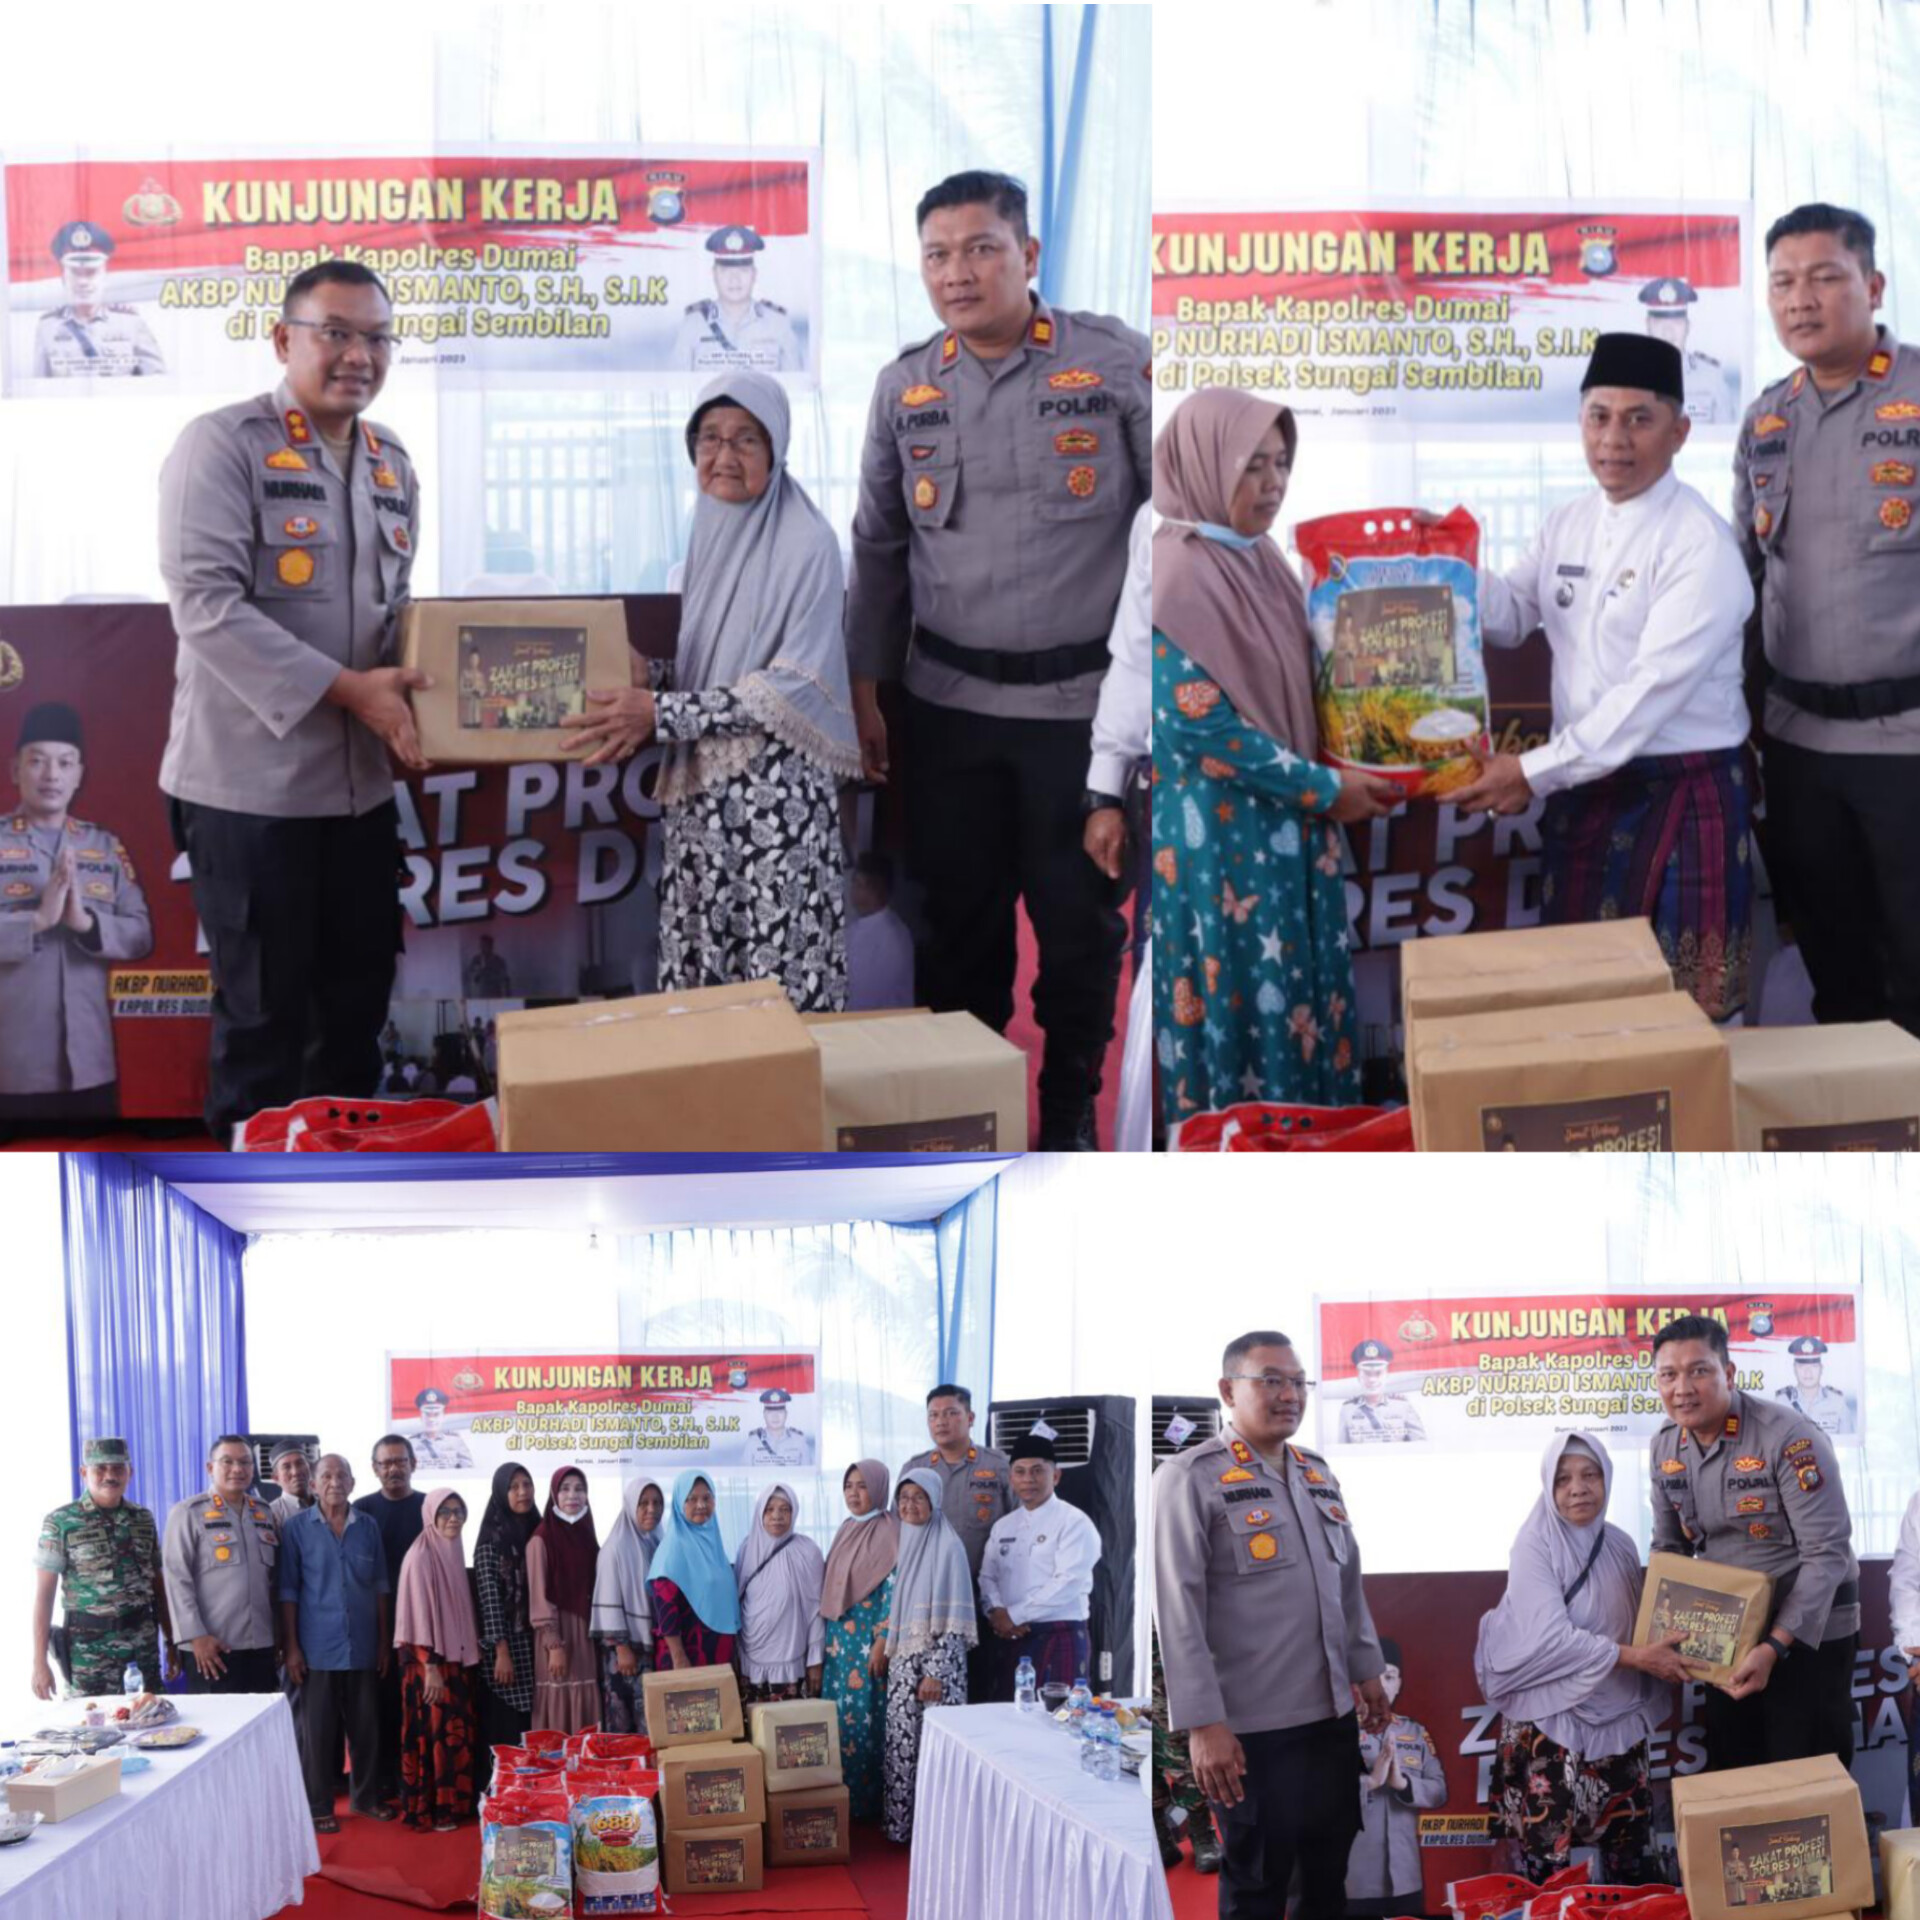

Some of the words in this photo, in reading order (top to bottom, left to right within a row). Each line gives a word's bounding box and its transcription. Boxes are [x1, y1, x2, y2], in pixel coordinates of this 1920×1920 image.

[203, 178, 465, 226] KUNJUNGAN
[481, 177, 620, 225] KERJA
[244, 245, 336, 275] Bapak
[342, 244, 476, 275] Kapolres
[482, 242, 578, 272] Dumai
[1412, 231, 1552, 275] KERJA
[160, 279, 238, 308] AKBP
[386, 275, 529, 309] ISMANTO,
[535, 276, 598, 310] S.H.,
[604, 276, 669, 306] S.I.K
[1176, 295, 1267, 327] Bapak
[1275, 295, 1408, 328] Kapolres
[1413, 294, 1511, 323] Dumai
[226, 310, 256, 338] di
[392, 308, 467, 343] ngai
[473, 309, 611, 338] Sembilan
[1174, 327, 1312, 357] NURHADI
[1317, 326, 1461, 361] ISMANTO,
[1467, 327, 1531, 361] S.H.,
[1536, 327, 1600, 357] S.I.K
[1157, 362, 1186, 391] di
[1192, 362, 1290, 390] Polsek
[1295, 359, 1398, 396] Sungai
[1403, 360, 1542, 390] Sembilan
[1039, 393, 1108, 417] POLRI
[1861, 428, 1920, 448] POLR
[114, 975, 150, 994] AKBP
[119, 999, 178, 1014] KAPOLRES
[1451, 1308, 1626, 1340] KUNJUNGAN
[1479, 1352, 1540, 1374] Bapak
[1545, 1350, 1633, 1374] Kapolres
[494, 1366, 632, 1390] KUNJUNGAN
[640, 1365, 714, 1389] KERJA
[1422, 1376, 1475, 1397] AKBP
[1479, 1374, 1569, 1395] NURHADI
[1574, 1372, 1658, 1394] ISMANTO
[516, 1400, 565, 1415] Bapak
[568, 1399, 637, 1415] Kapolres
[641, 1398, 693, 1414] Dumai
[1467, 1397, 1486, 1417] di
[1490, 1397, 1556, 1417] Polsek
[1560, 1394, 1628, 1419] Sungai
[471, 1418, 513, 1433] AKBP
[516, 1417, 587, 1432] NURHADI
[590, 1416, 667, 1434] ISMANTO,
[669, 1416, 703, 1434] S.H.,
[705, 1416, 740, 1432] S.I.K
[506, 1435, 522, 1450] di
[524, 1434, 577, 1450] Polsek
[579, 1433, 633, 1452] Sungai
[635, 1433, 710, 1449] Sembilan
[1749, 1848, 1782, 1868] ZAKAT
[1784, 1835, 1825, 1858] PROFESI
[1753, 1859, 1790, 1879] POLRES
